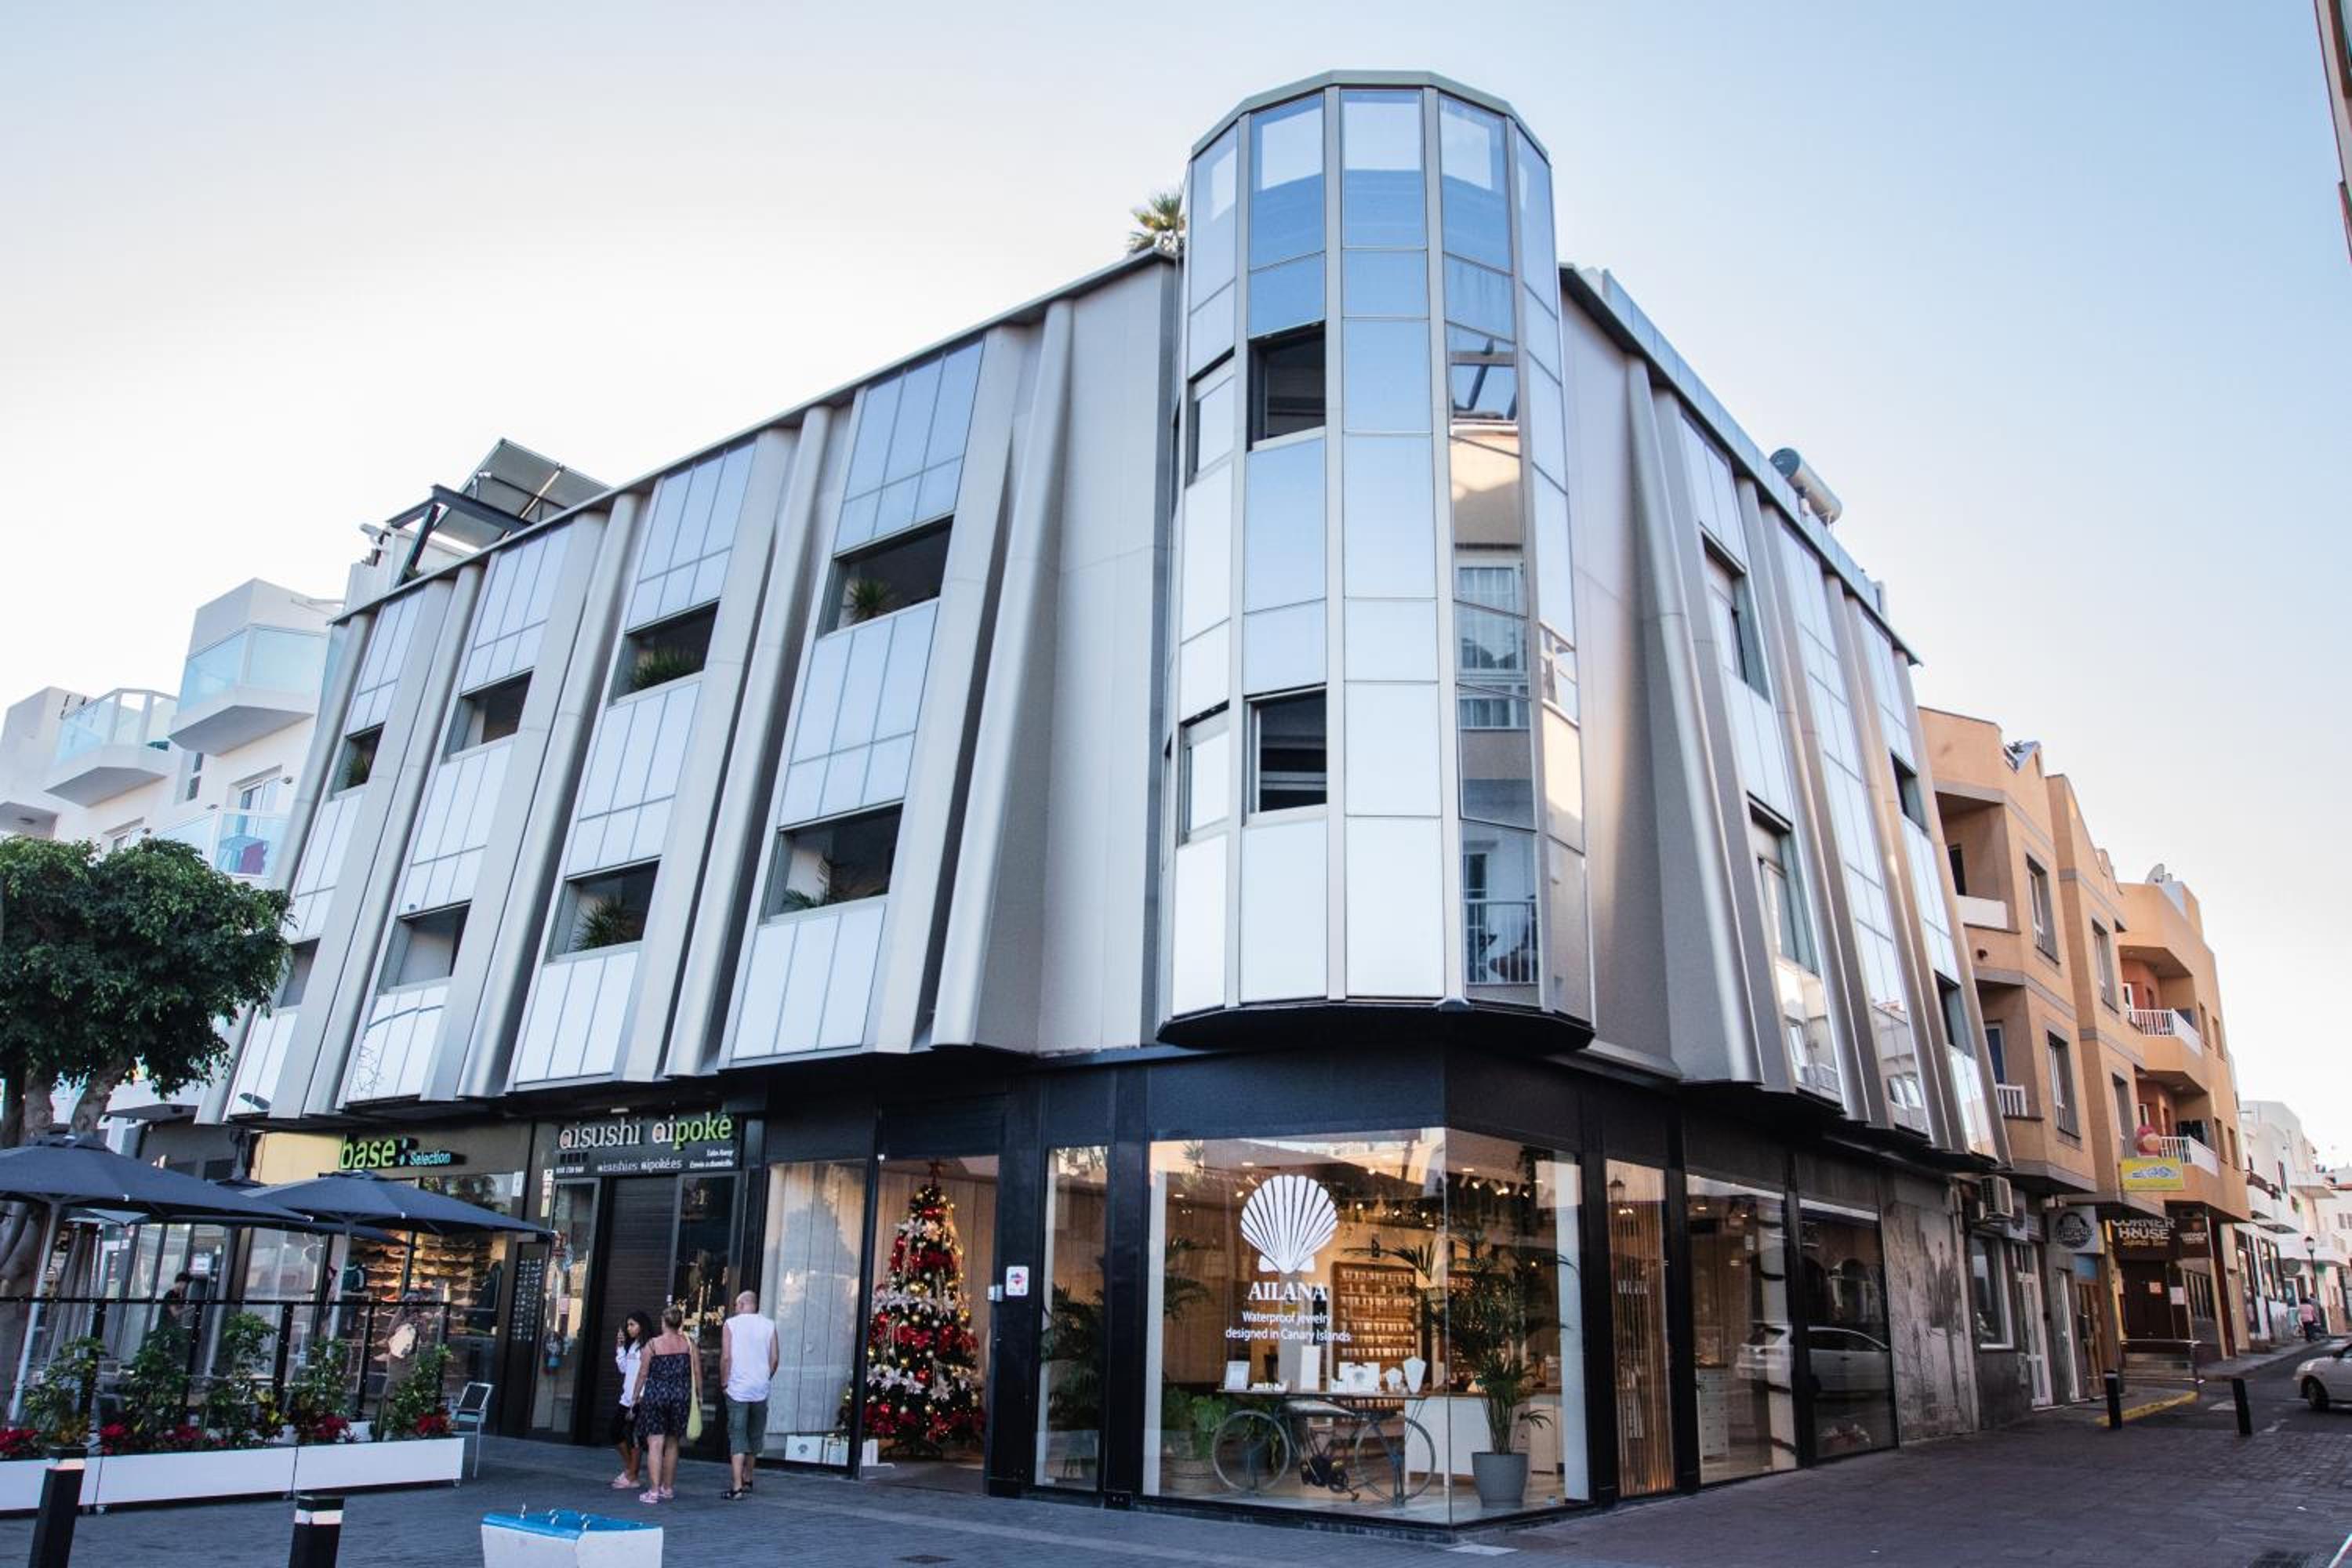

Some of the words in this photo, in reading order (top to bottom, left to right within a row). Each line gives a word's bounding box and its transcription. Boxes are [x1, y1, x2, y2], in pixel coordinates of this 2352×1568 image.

[559, 1117, 641, 1149] aisushi
[409, 1150, 451, 1166] Selection
[2119, 1227, 2170, 1240] HOUSE
[1247, 1282, 1327, 1301] AILANA
[1242, 1311, 1295, 1325] Waterproof
[1297, 1311, 1330, 1327] jewelry
[1225, 1327, 1266, 1341] designed
[1269, 1328, 1279, 1339] in
[1280, 1328, 1314, 1342] Canary
[1316, 1330, 1352, 1342] Islands
